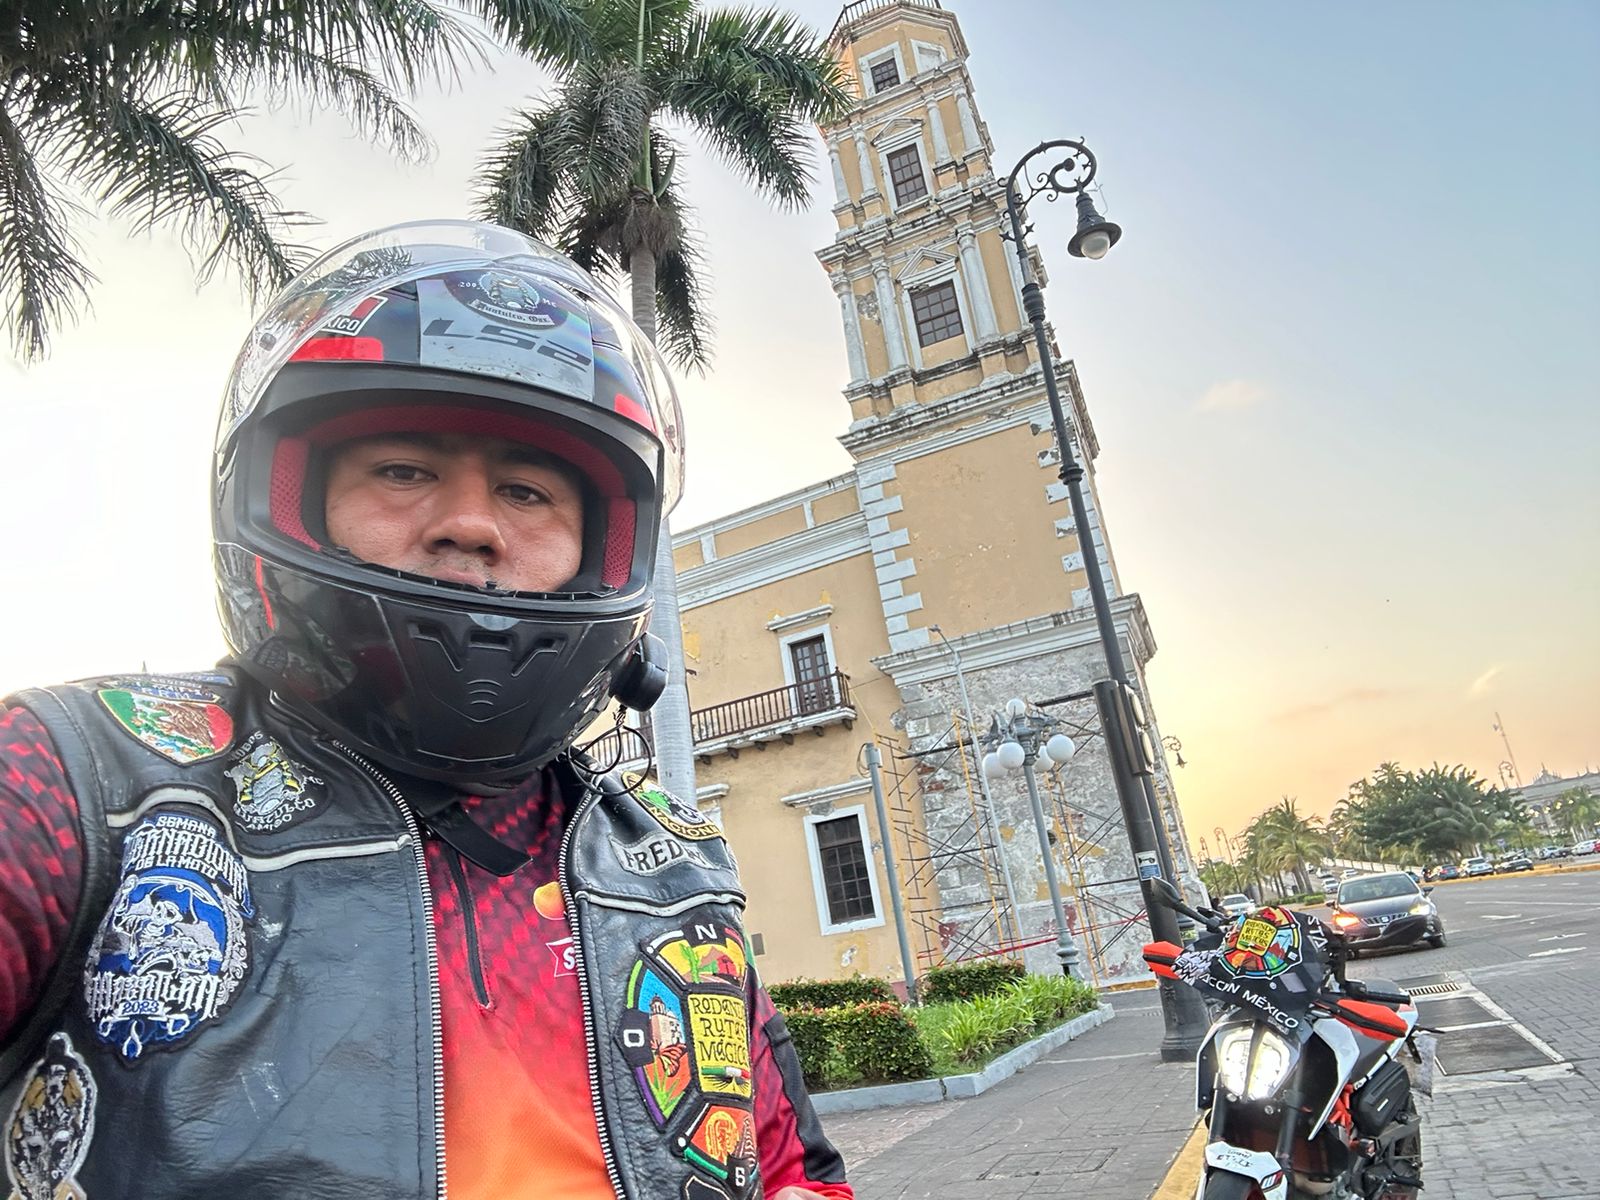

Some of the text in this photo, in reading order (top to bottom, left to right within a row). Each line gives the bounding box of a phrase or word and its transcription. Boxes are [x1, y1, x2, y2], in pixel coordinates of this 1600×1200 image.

[423, 319, 593, 373] LS2
[156, 815, 217, 838] SEMANA
[177, 856, 218, 880] MOTO
[695, 923, 718, 939] N
[122, 1001, 160, 1014] 2023
[1242, 989, 1300, 1029] MÉXICO
